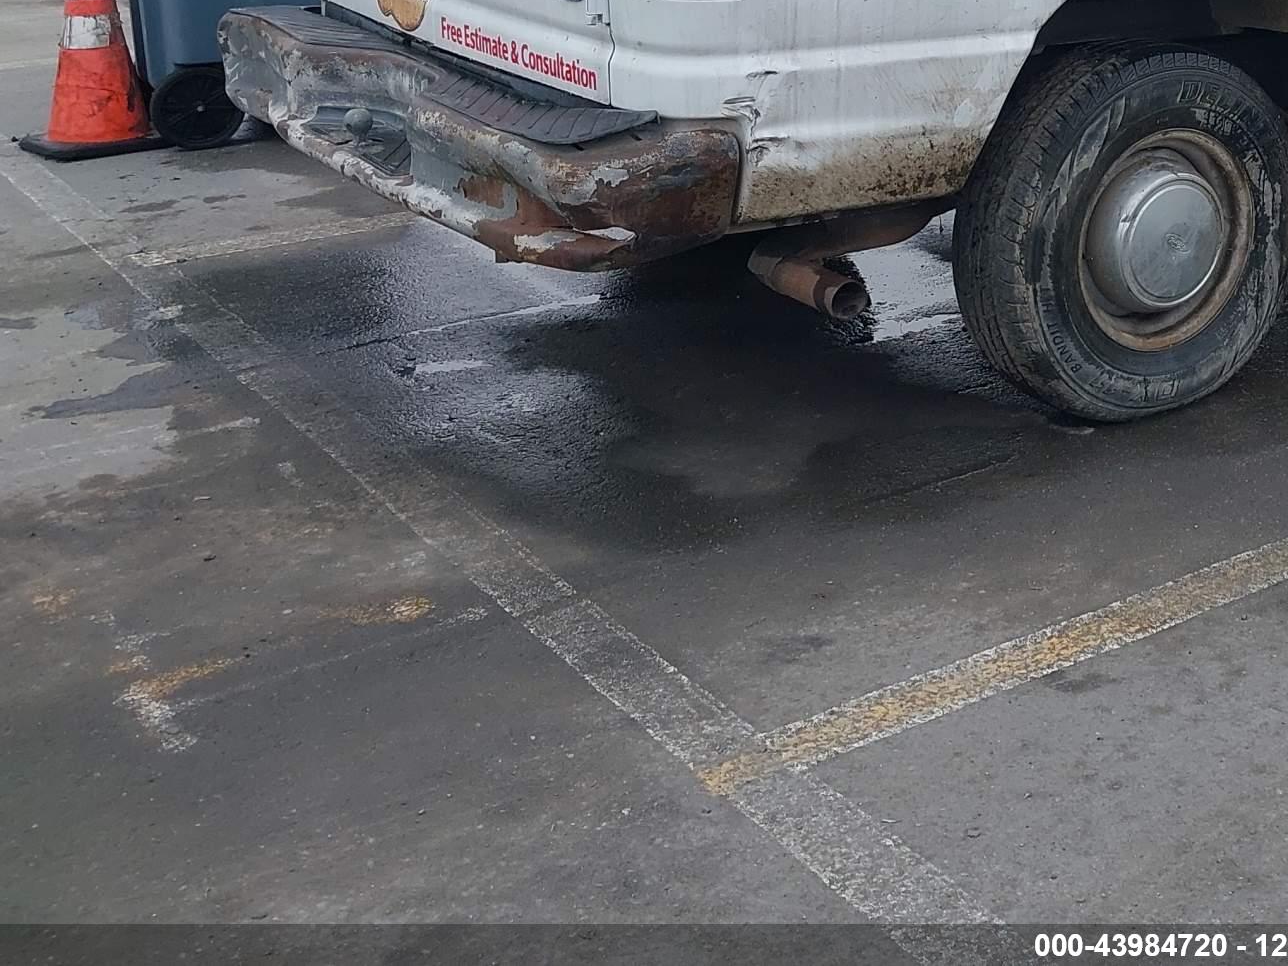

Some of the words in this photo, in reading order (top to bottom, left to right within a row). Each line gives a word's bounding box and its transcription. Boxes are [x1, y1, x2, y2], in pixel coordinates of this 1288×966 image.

[441, 16, 463, 45] Free
[463, 24, 509, 61] Estimate
[510, 40, 519, 65] &
[521, 44, 597, 91] Consultation
